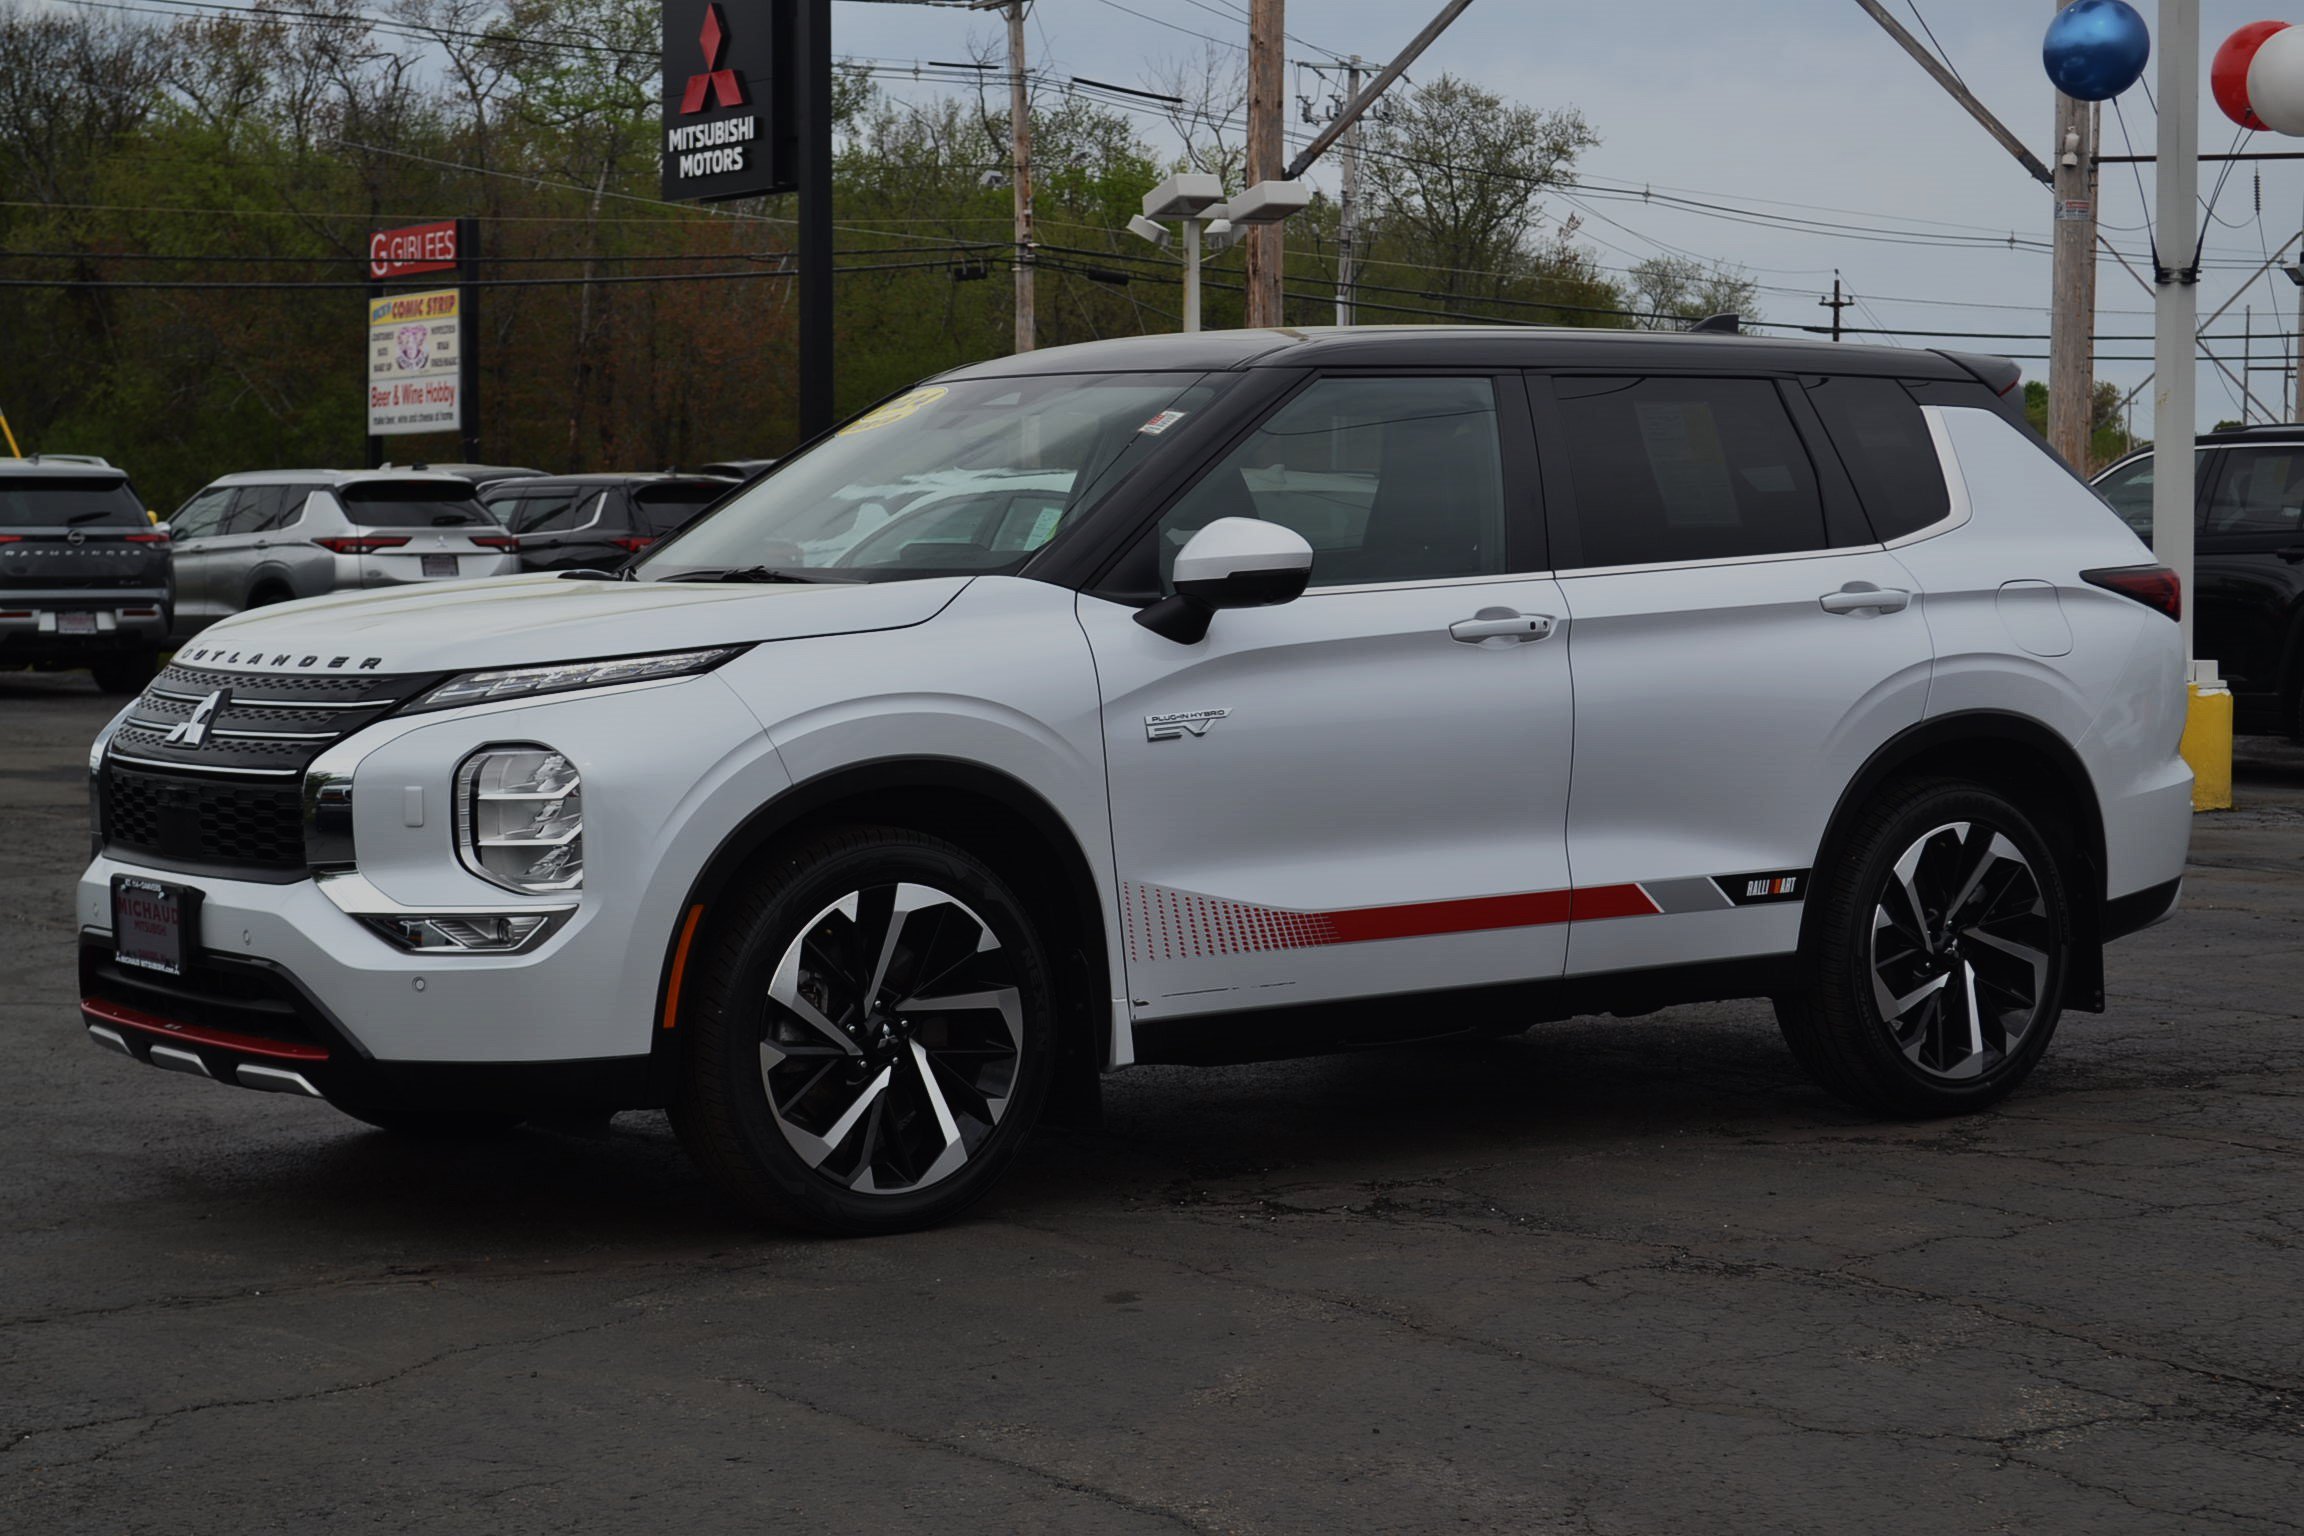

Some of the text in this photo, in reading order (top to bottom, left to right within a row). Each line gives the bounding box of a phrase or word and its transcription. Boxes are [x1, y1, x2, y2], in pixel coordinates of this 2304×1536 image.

[668, 115, 755, 152] MITSUBISHI
[679, 146, 744, 179] MOTORS
[371, 386, 391, 408] Beer
[402, 383, 424, 405] Wine
[426, 381, 455, 408] Hobby
[181, 648, 383, 670] OUTLANDER
[1145, 718, 1217, 743] EV
[1151, 713, 1189, 722] PLUG-IN
[117, 896, 181, 925] MICHAUD
